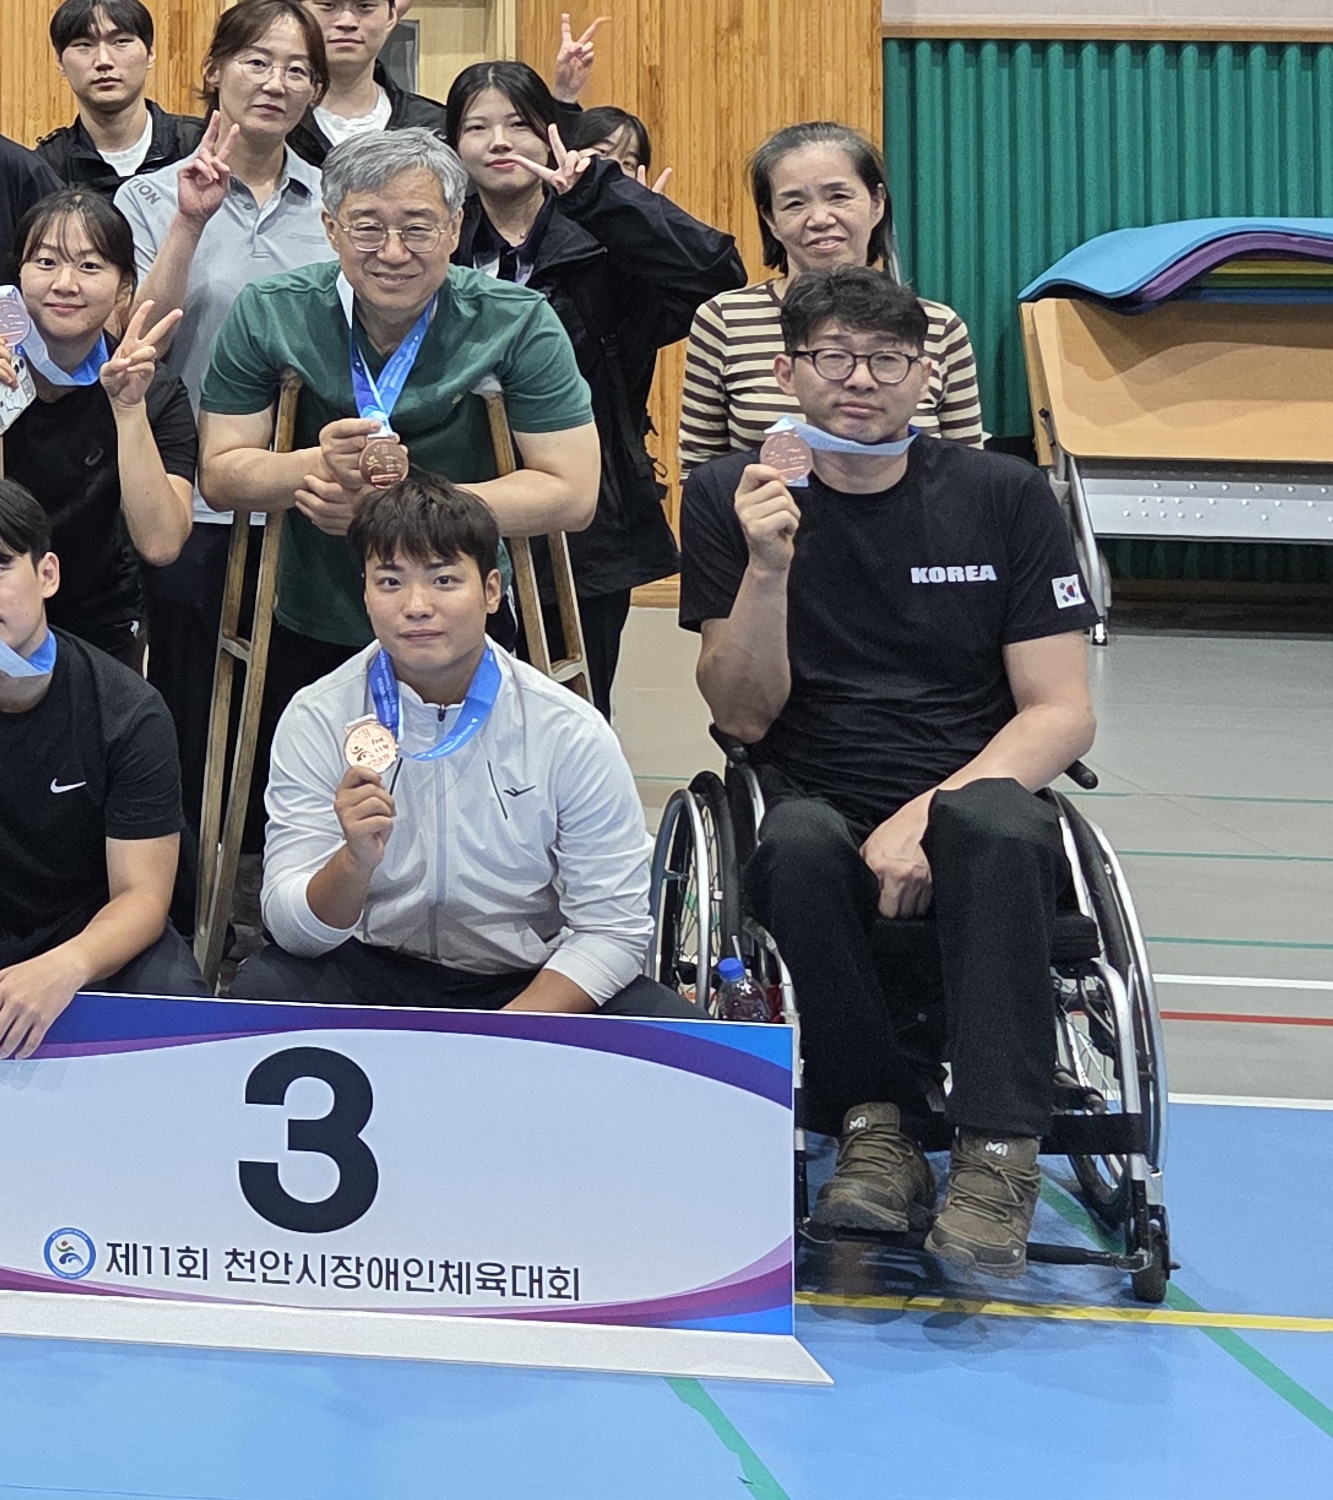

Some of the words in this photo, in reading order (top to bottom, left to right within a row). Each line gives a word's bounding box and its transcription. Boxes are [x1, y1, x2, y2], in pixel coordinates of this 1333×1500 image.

[910, 564, 998, 584] KOREA
[237, 1045, 380, 1234] 3
[104, 1240, 209, 1281] 제11회
[224, 1247, 581, 1302] 천안시장애인체육대회
